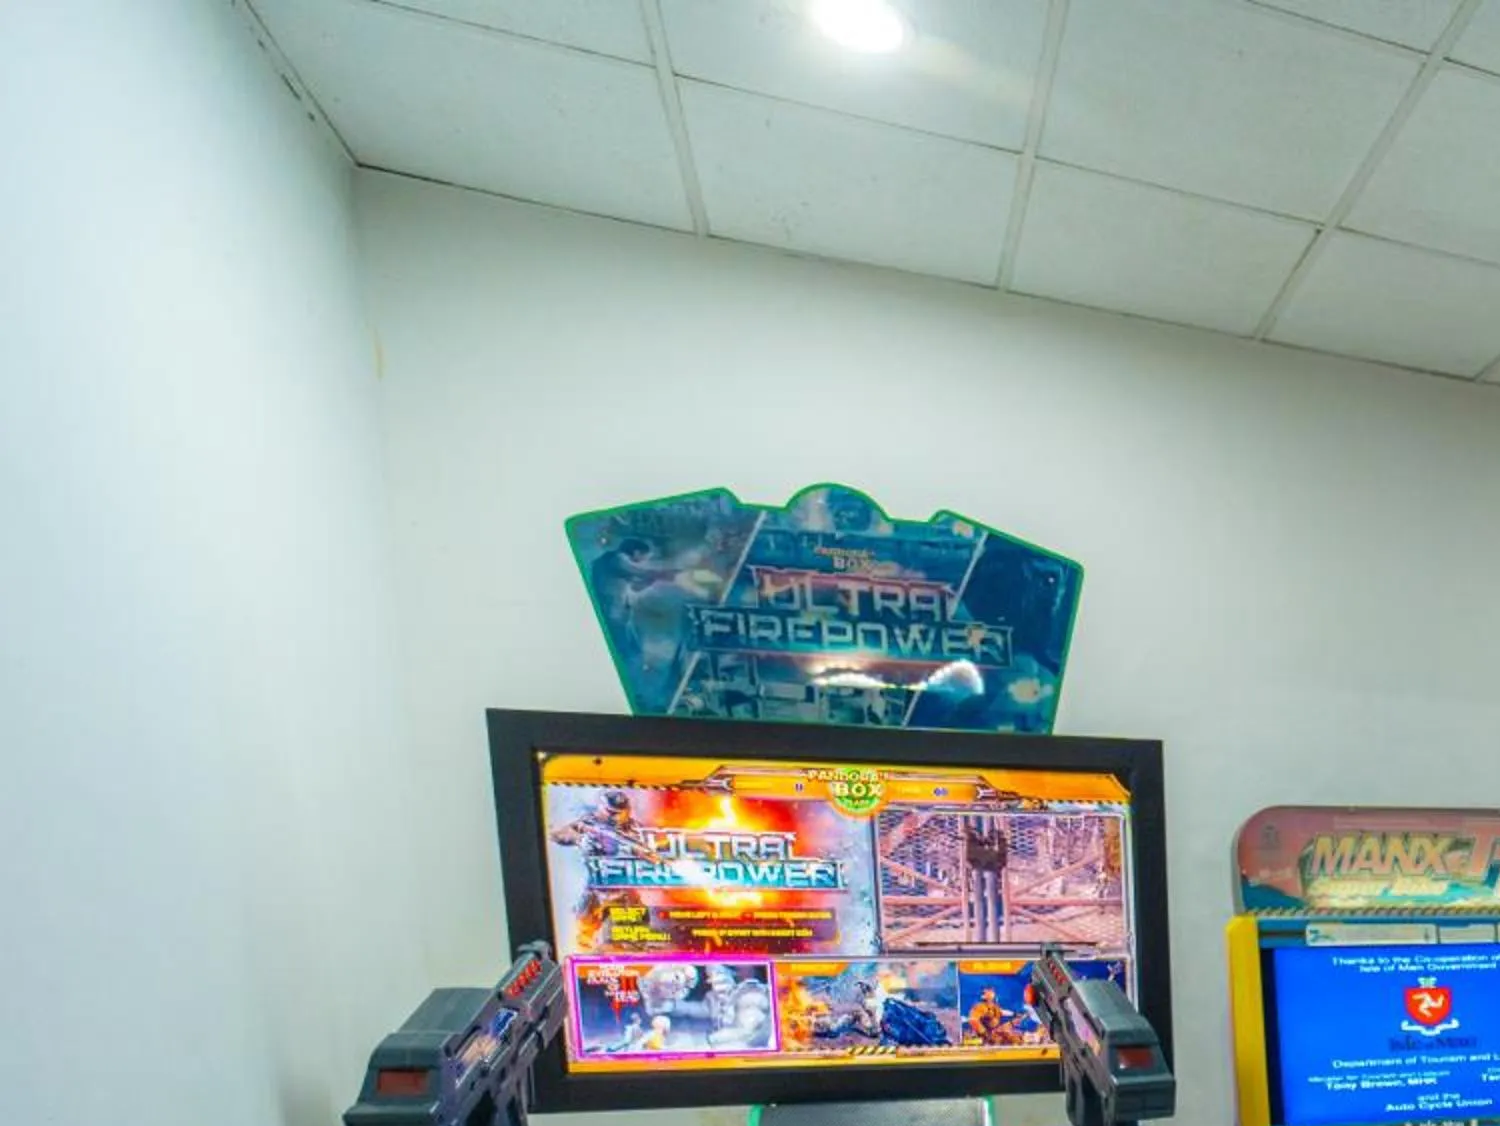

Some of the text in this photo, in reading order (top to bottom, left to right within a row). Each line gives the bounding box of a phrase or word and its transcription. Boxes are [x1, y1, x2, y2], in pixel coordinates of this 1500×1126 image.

[702, 610, 1004, 662] FIREPOWER
[834, 782, 883, 797] BOX
[1311, 833, 1452, 877] MANX
[1332, 1058, 1403, 1069] Department
[1385, 1103, 1416, 1112] Auto
